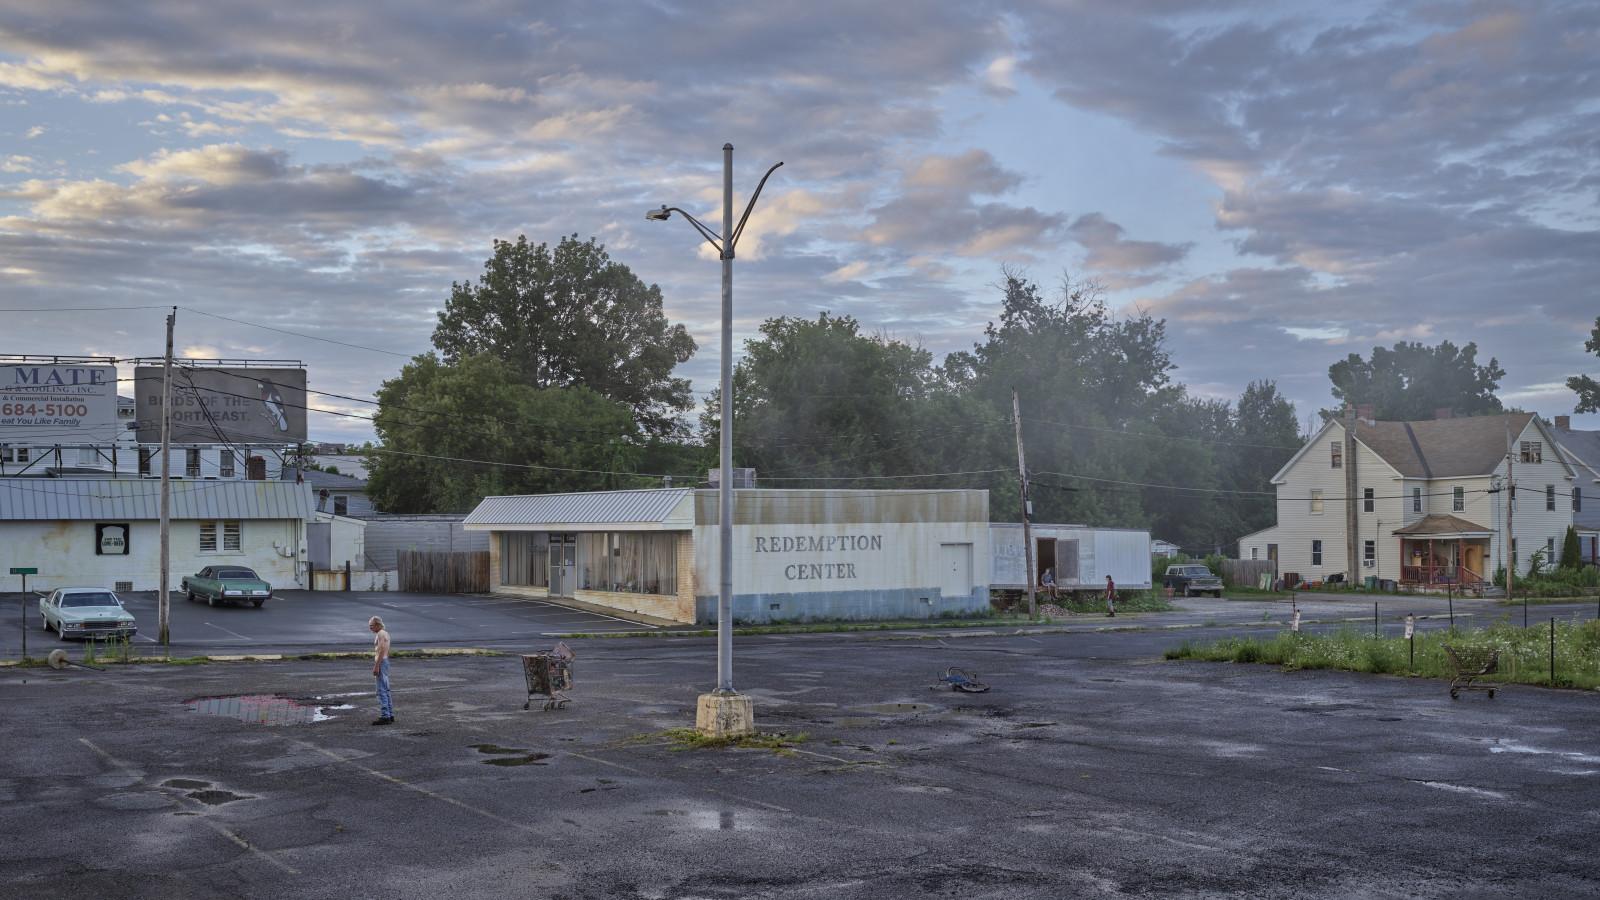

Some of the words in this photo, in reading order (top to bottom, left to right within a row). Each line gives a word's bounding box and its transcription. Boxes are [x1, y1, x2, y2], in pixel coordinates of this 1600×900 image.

[14, 367, 106, 385] MATE
[149, 395, 194, 407] BIDS
[200, 396, 218, 407] OF
[223, 396, 251, 407] THE
[2, 403, 88, 417] 684-5100
[169, 411, 251, 421] ORTHEAST.
[16, 417, 33, 425] You
[34, 417, 52, 425] Like
[52, 417, 81, 426] Family
[754, 535, 883, 553] REDEMPTION
[784, 563, 857, 581] CENTER
